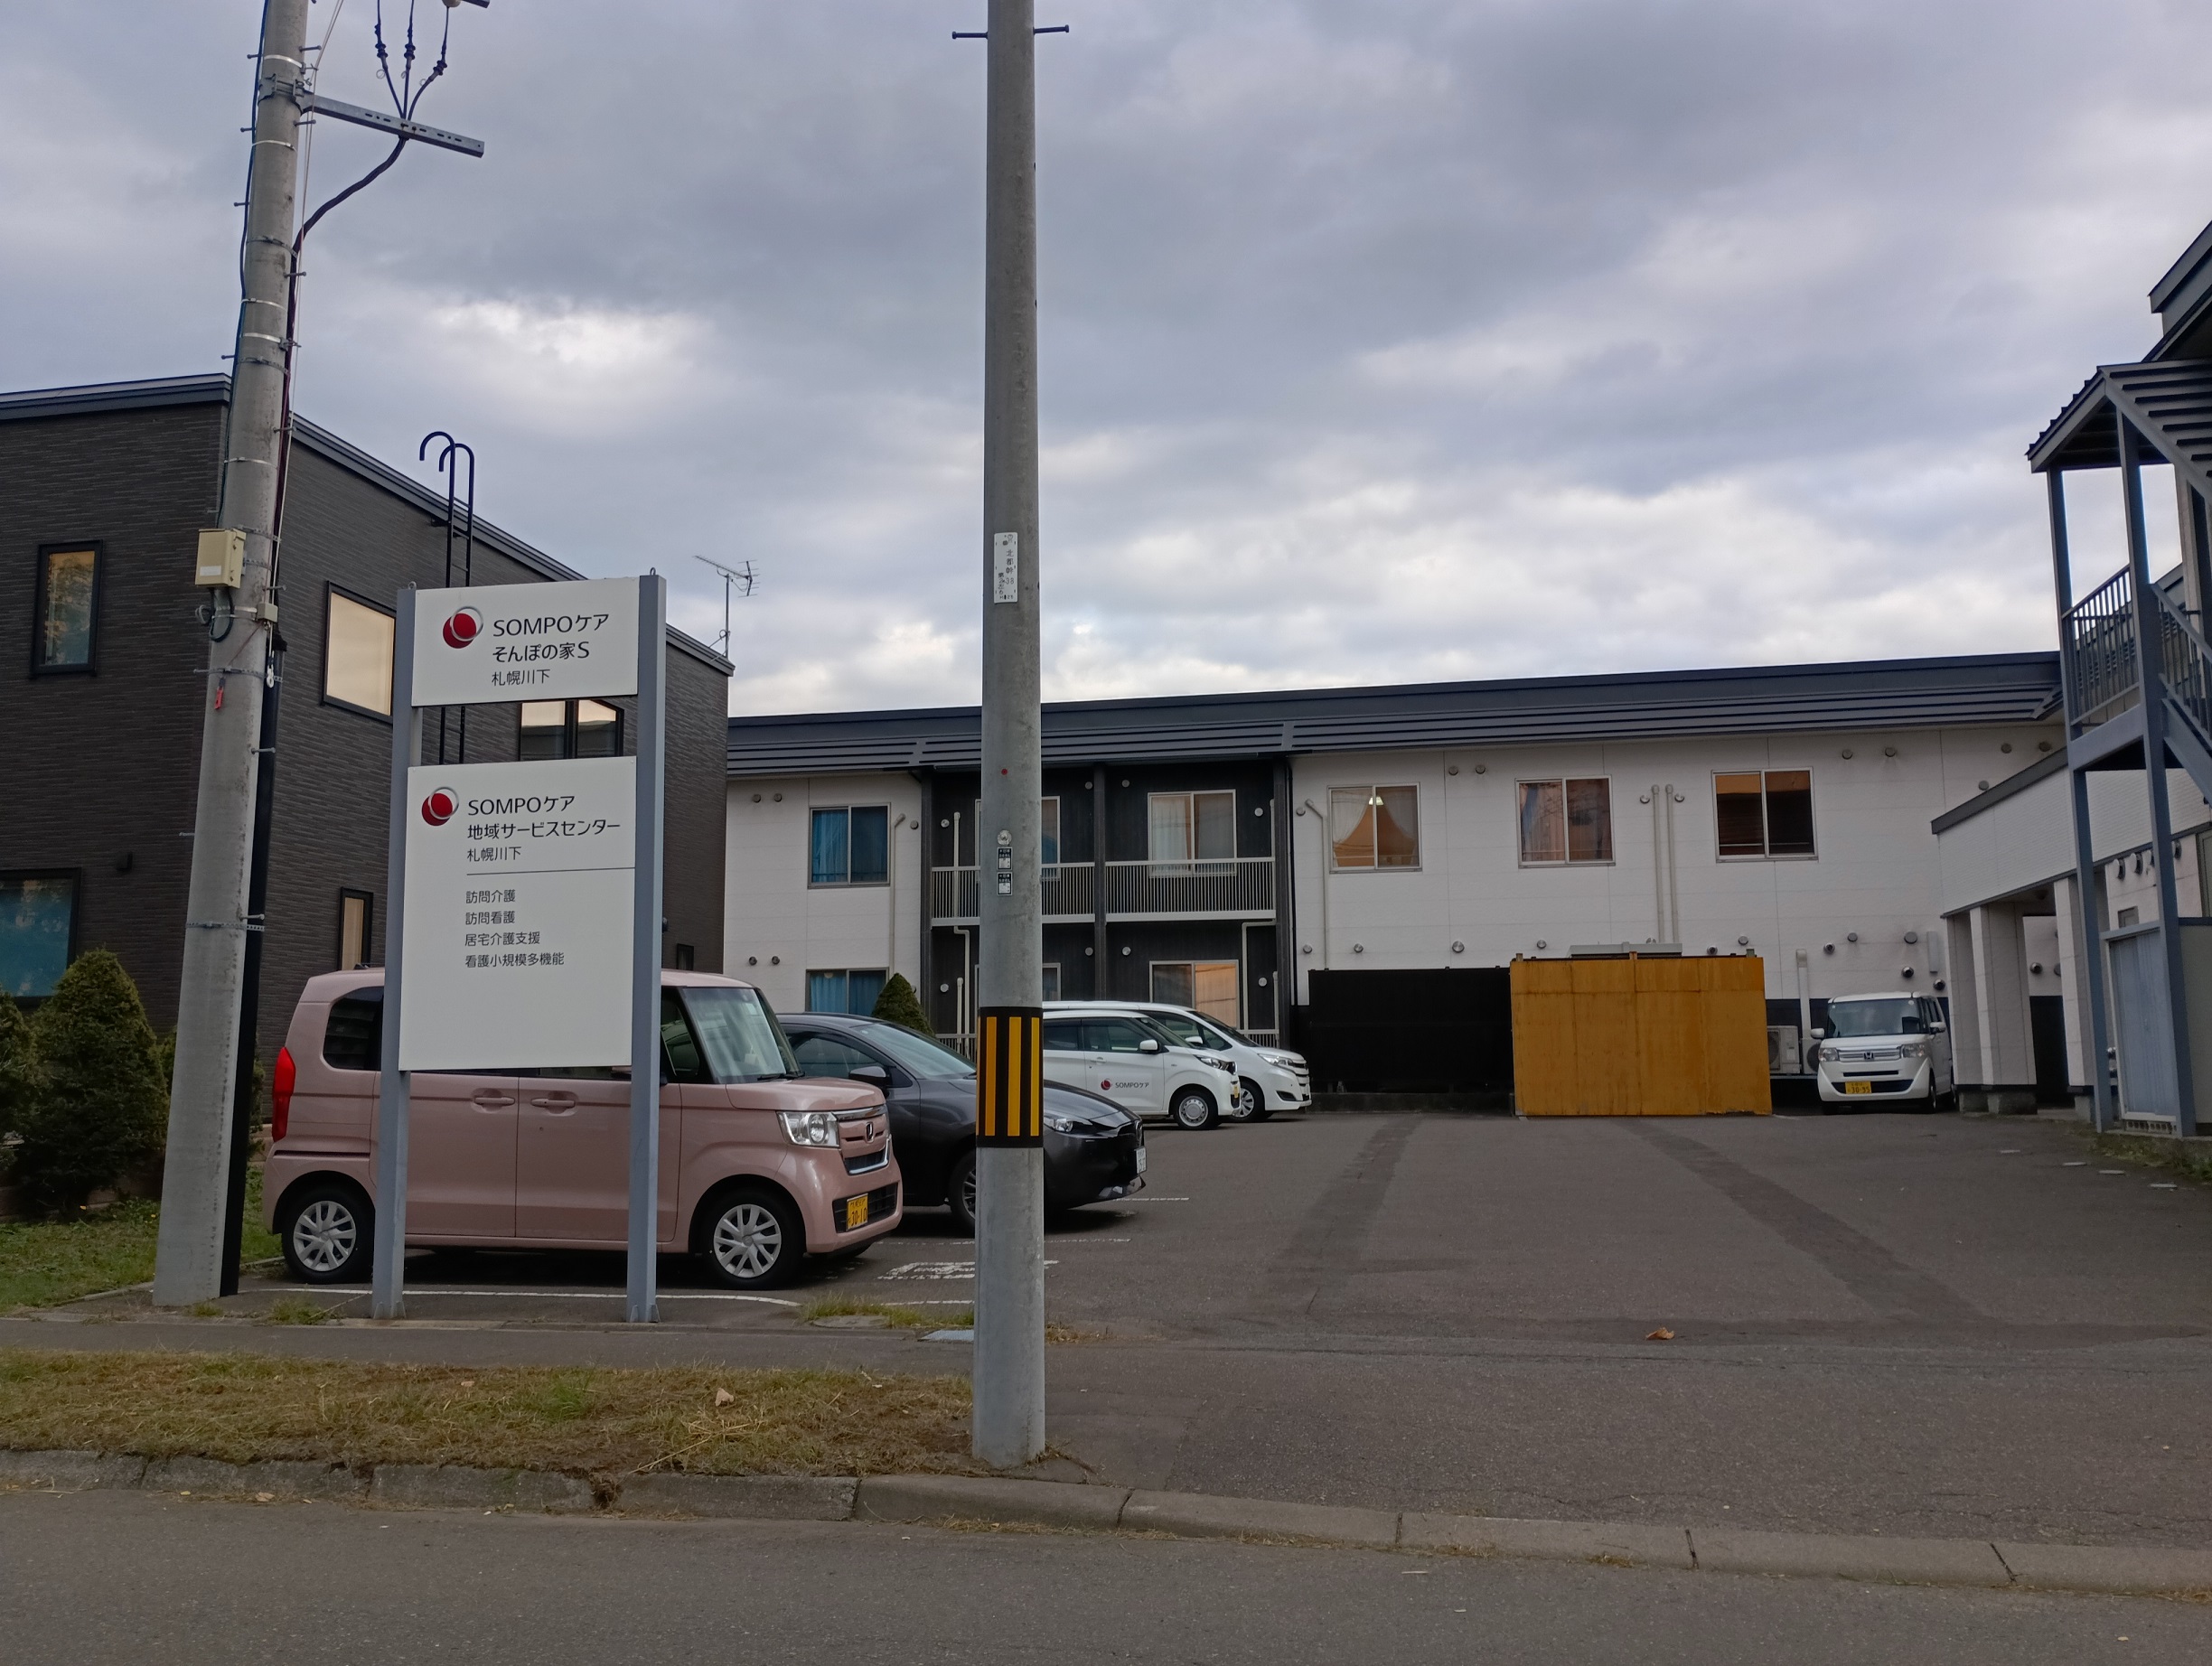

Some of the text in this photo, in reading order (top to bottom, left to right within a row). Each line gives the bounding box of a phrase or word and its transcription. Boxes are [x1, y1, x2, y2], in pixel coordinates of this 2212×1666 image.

[493, 614, 609, 637] SOMPOケア
[492, 641, 590, 663] そんぽの家S
[492, 669, 550, 687] 札幌川下
[467, 795, 576, 816] SOMPOケア
[467, 819, 621, 840] 地域サービスセンター
[466, 847, 522, 862] 札幌川下
[465, 889, 516, 904] 訪問介護
[465, 911, 516, 925] 訪問看護
[464, 931, 540, 947] 居宅介護支援
[464, 952, 565, 969] 看護小規模多機能
[1115, 1081, 1150, 1090] SOMPOケア
